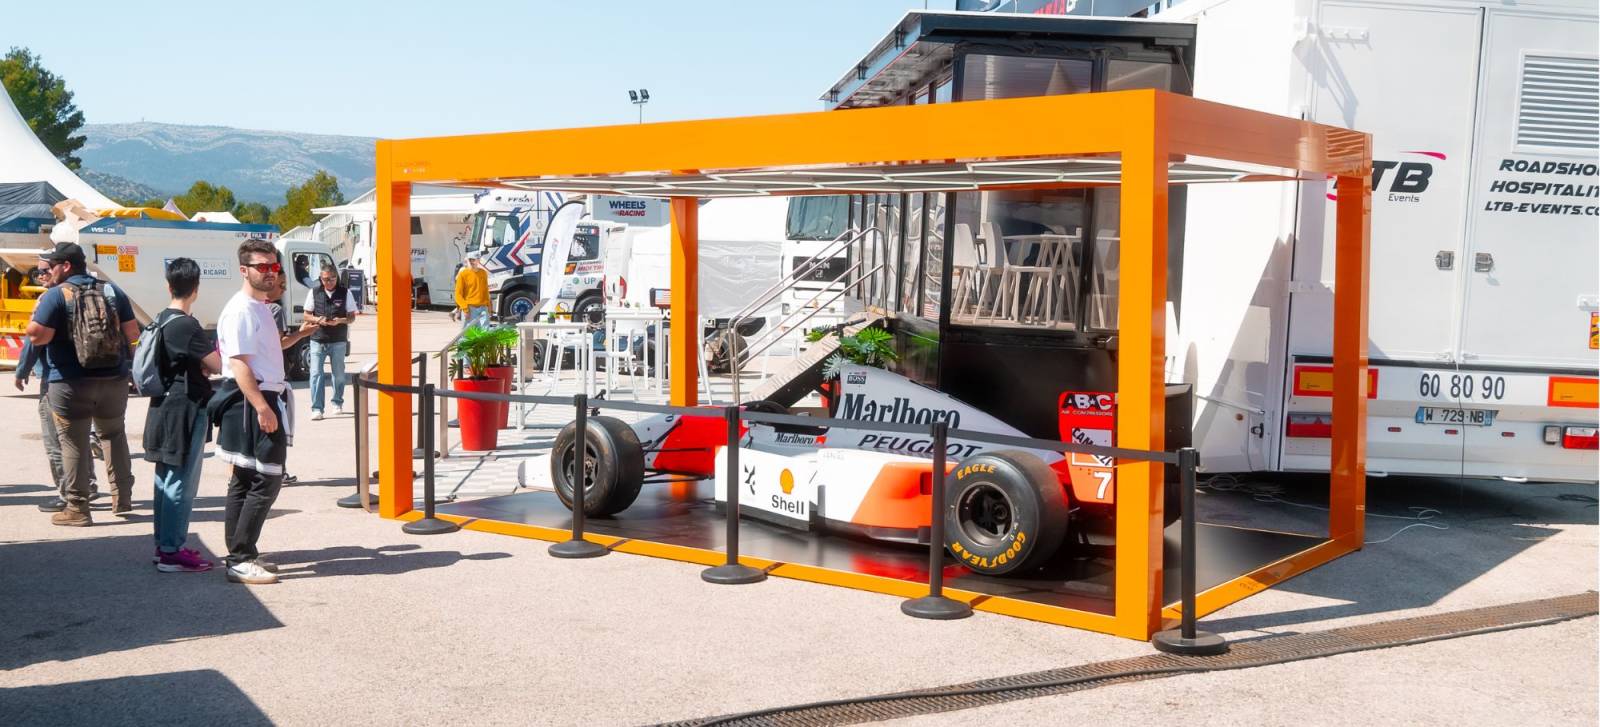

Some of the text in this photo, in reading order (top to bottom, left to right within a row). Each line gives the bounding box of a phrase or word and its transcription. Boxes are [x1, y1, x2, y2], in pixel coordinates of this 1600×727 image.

[1499, 159, 1599, 176] ROADSHO
[609, 201, 646, 210] WHEELS
[1388, 193, 1420, 202] Events
[1420, 373, 1505, 400] 60 80 90
[842, 393, 961, 430] Marlboro
[773, 432, 814, 445] Marlboro
[956, 464, 997, 480] EAGLE
[1094, 471, 1112, 499] 7
[771, 494, 805, 515] Shell
[951, 532, 1026, 568] GOODYEAR
